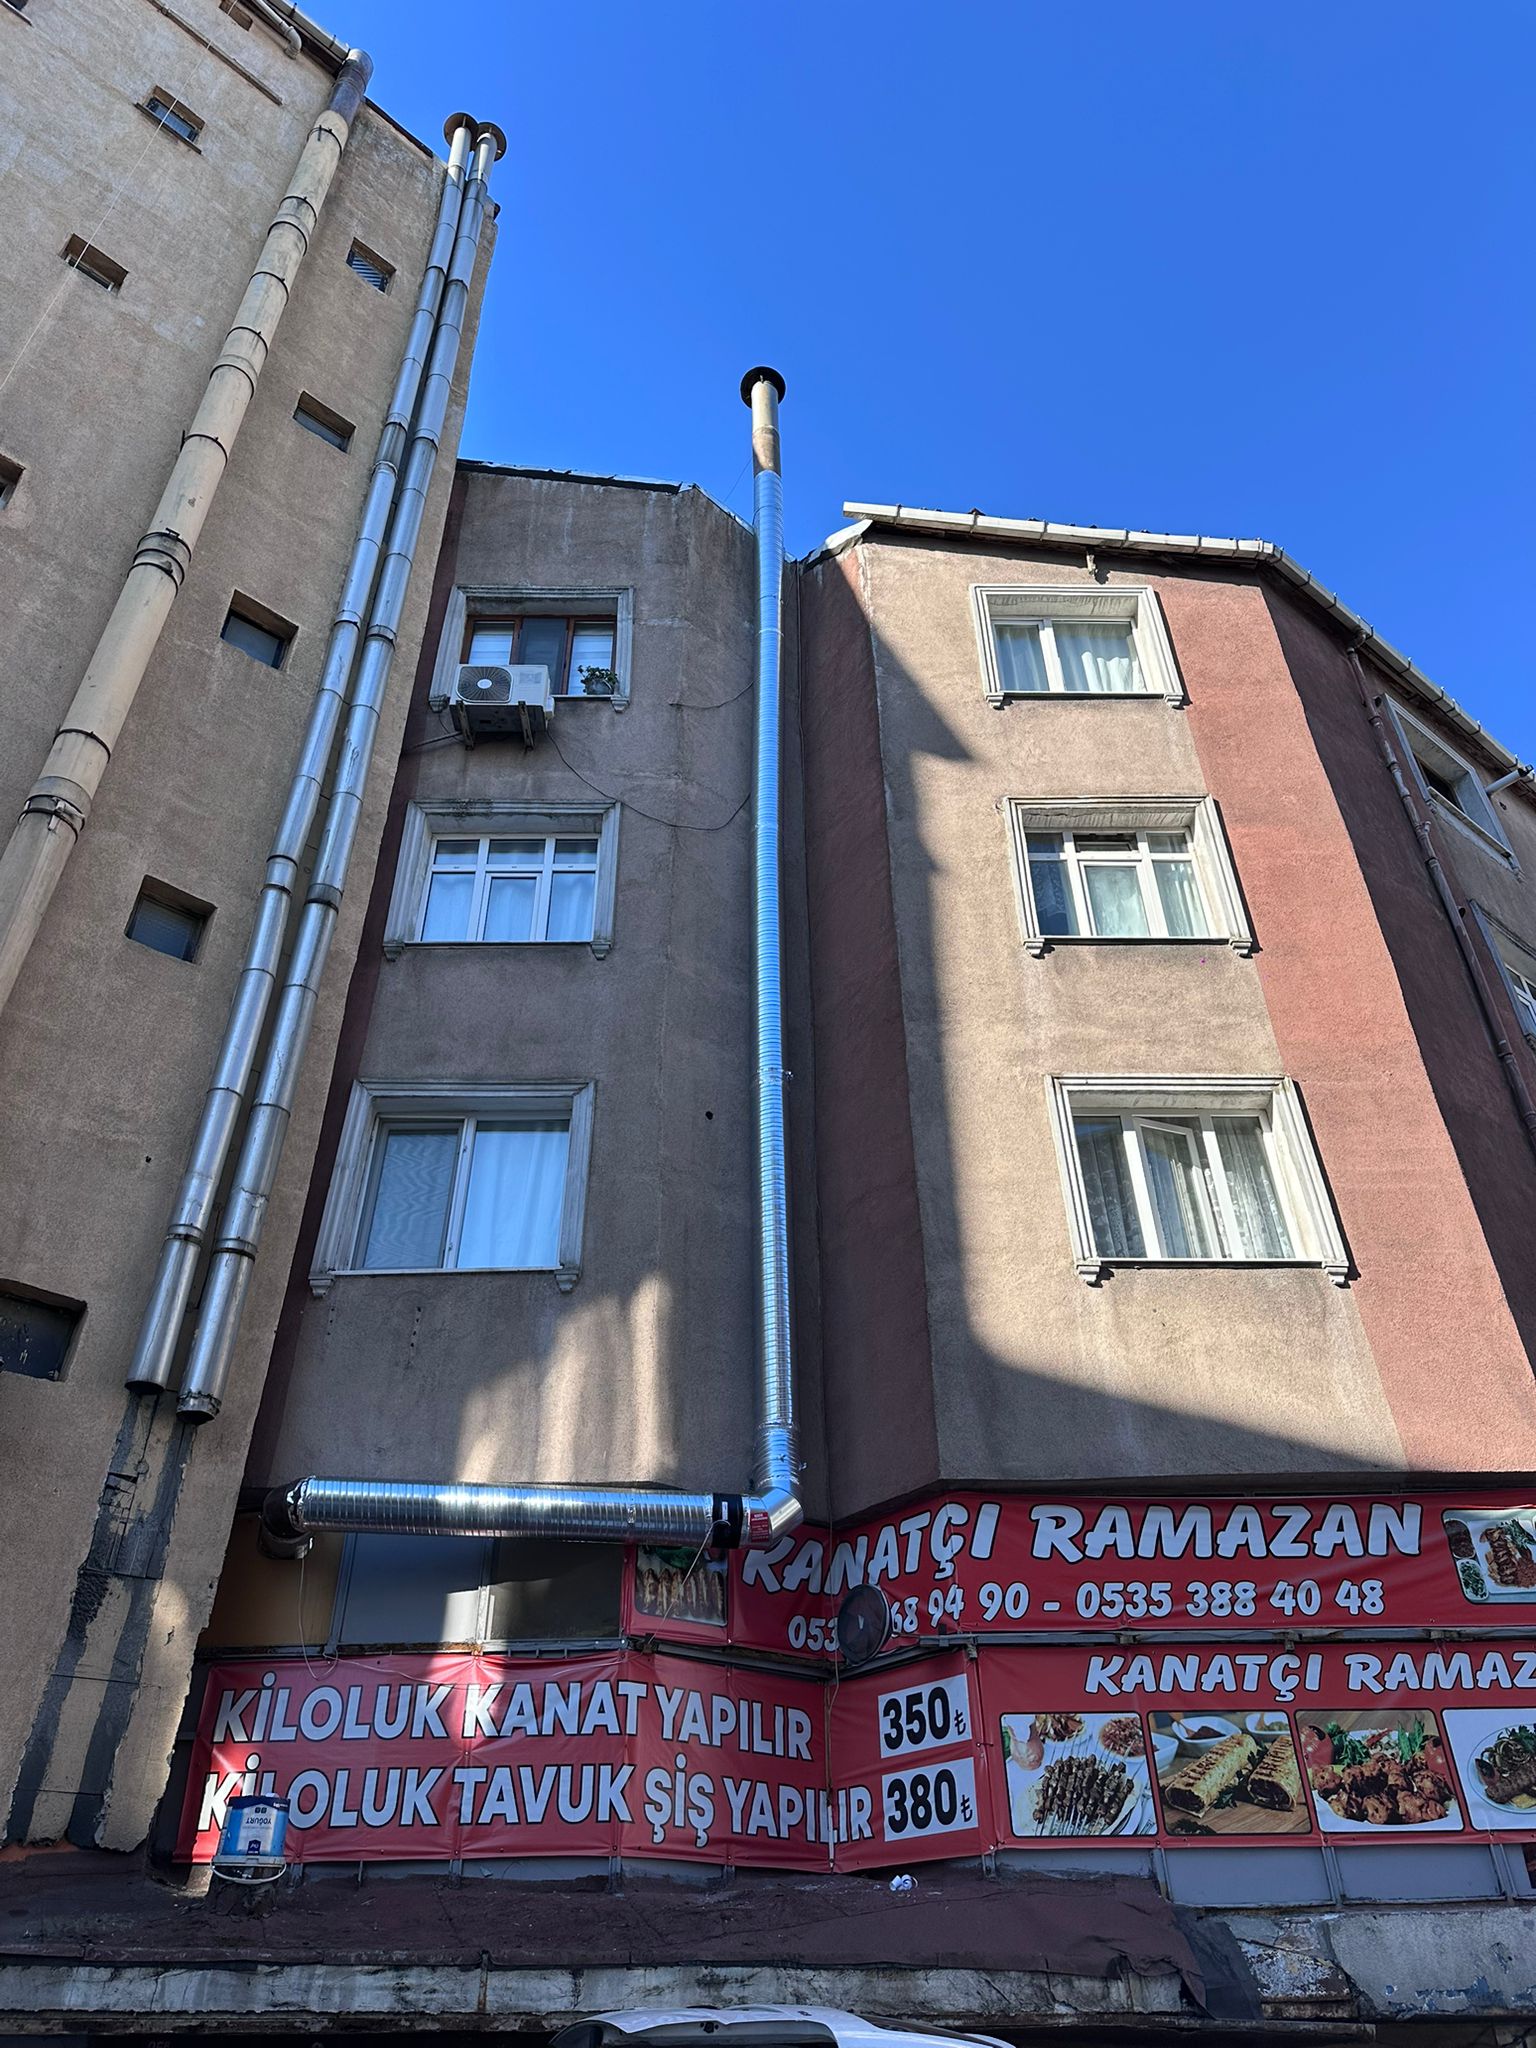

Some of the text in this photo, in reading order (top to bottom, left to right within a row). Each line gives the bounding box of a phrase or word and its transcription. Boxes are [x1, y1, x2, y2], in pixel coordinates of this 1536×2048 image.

[741, 1501, 1423, 1594] KANATÇI RAMAZAN
[927, 1582, 965, 1628] 94
[977, 1581, 1030, 1621] 90
[1042, 1599, 1061, 1612] -
[1076, 1581, 1174, 1619] 0535
[1185, 1580, 1257, 1618] 388
[1268, 1579, 1324, 1616] 40
[1334, 1578, 1386, 1616] 48
[211, 1670, 815, 1762] KİLOLUK KANAT YAPILIR
[1084, 1652, 1324, 1702] KANATÇI
[453, 1764, 637, 1828] TAVUK
[643, 1752, 716, 1849] ŞİŞ
[721, 1775, 876, 1845] YAPILIR
